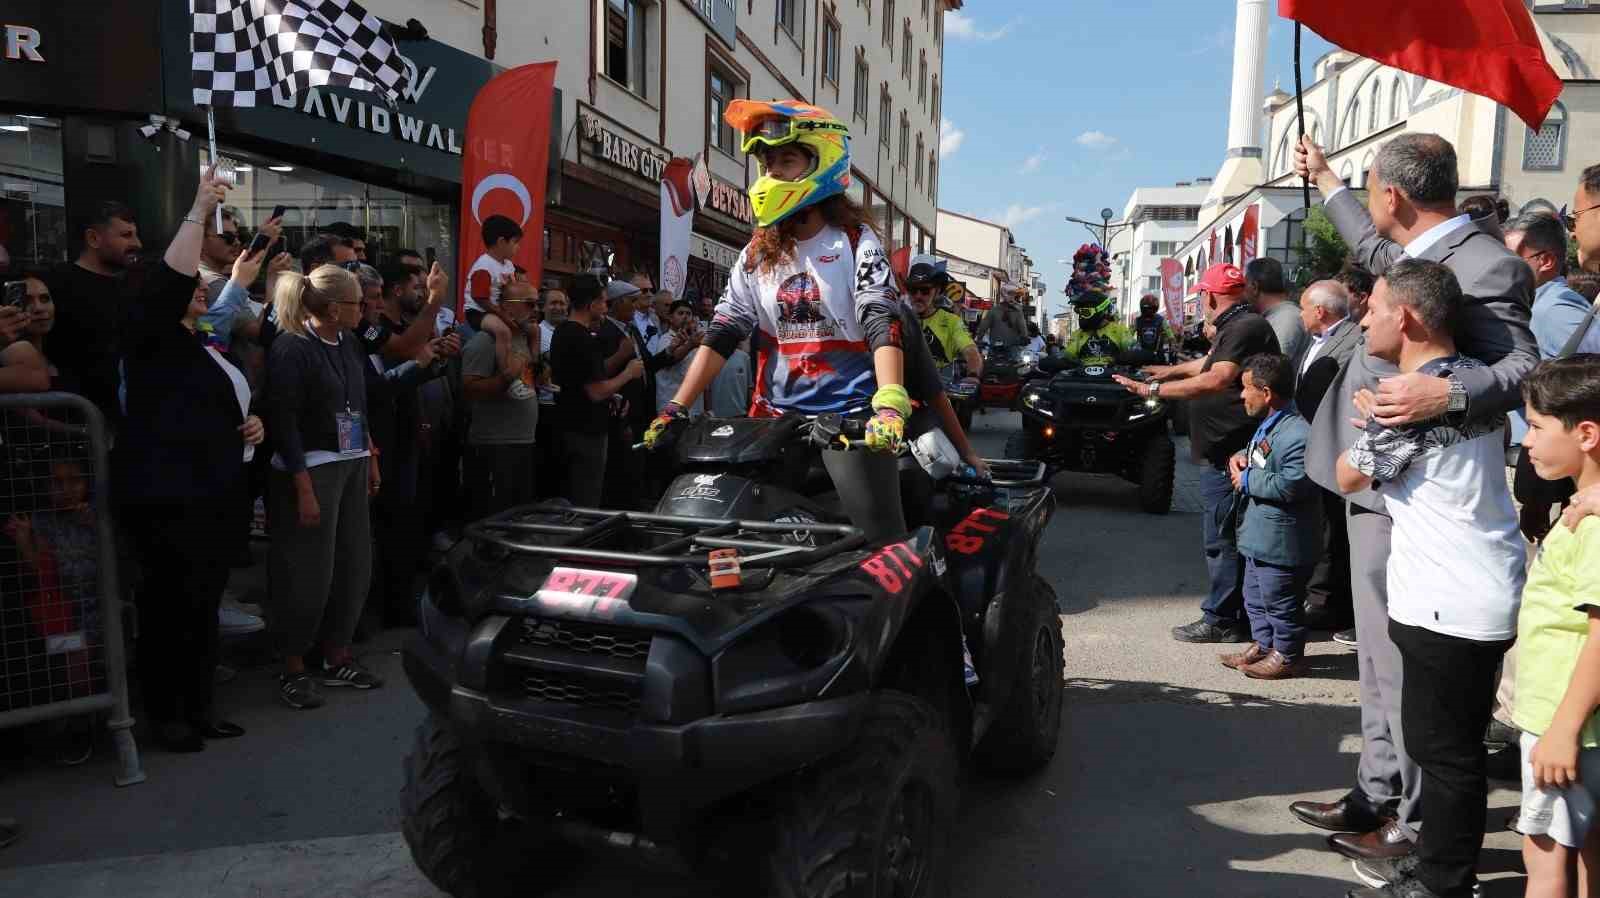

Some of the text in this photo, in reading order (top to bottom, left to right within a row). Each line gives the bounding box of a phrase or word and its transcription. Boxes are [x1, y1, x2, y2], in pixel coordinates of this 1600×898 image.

[4, 24, 46, 62] R
[602, 130, 639, 171] BARS
[945, 508, 1009, 554] 877
[861, 543, 923, 593] 877
[544, 572, 630, 611] 877
